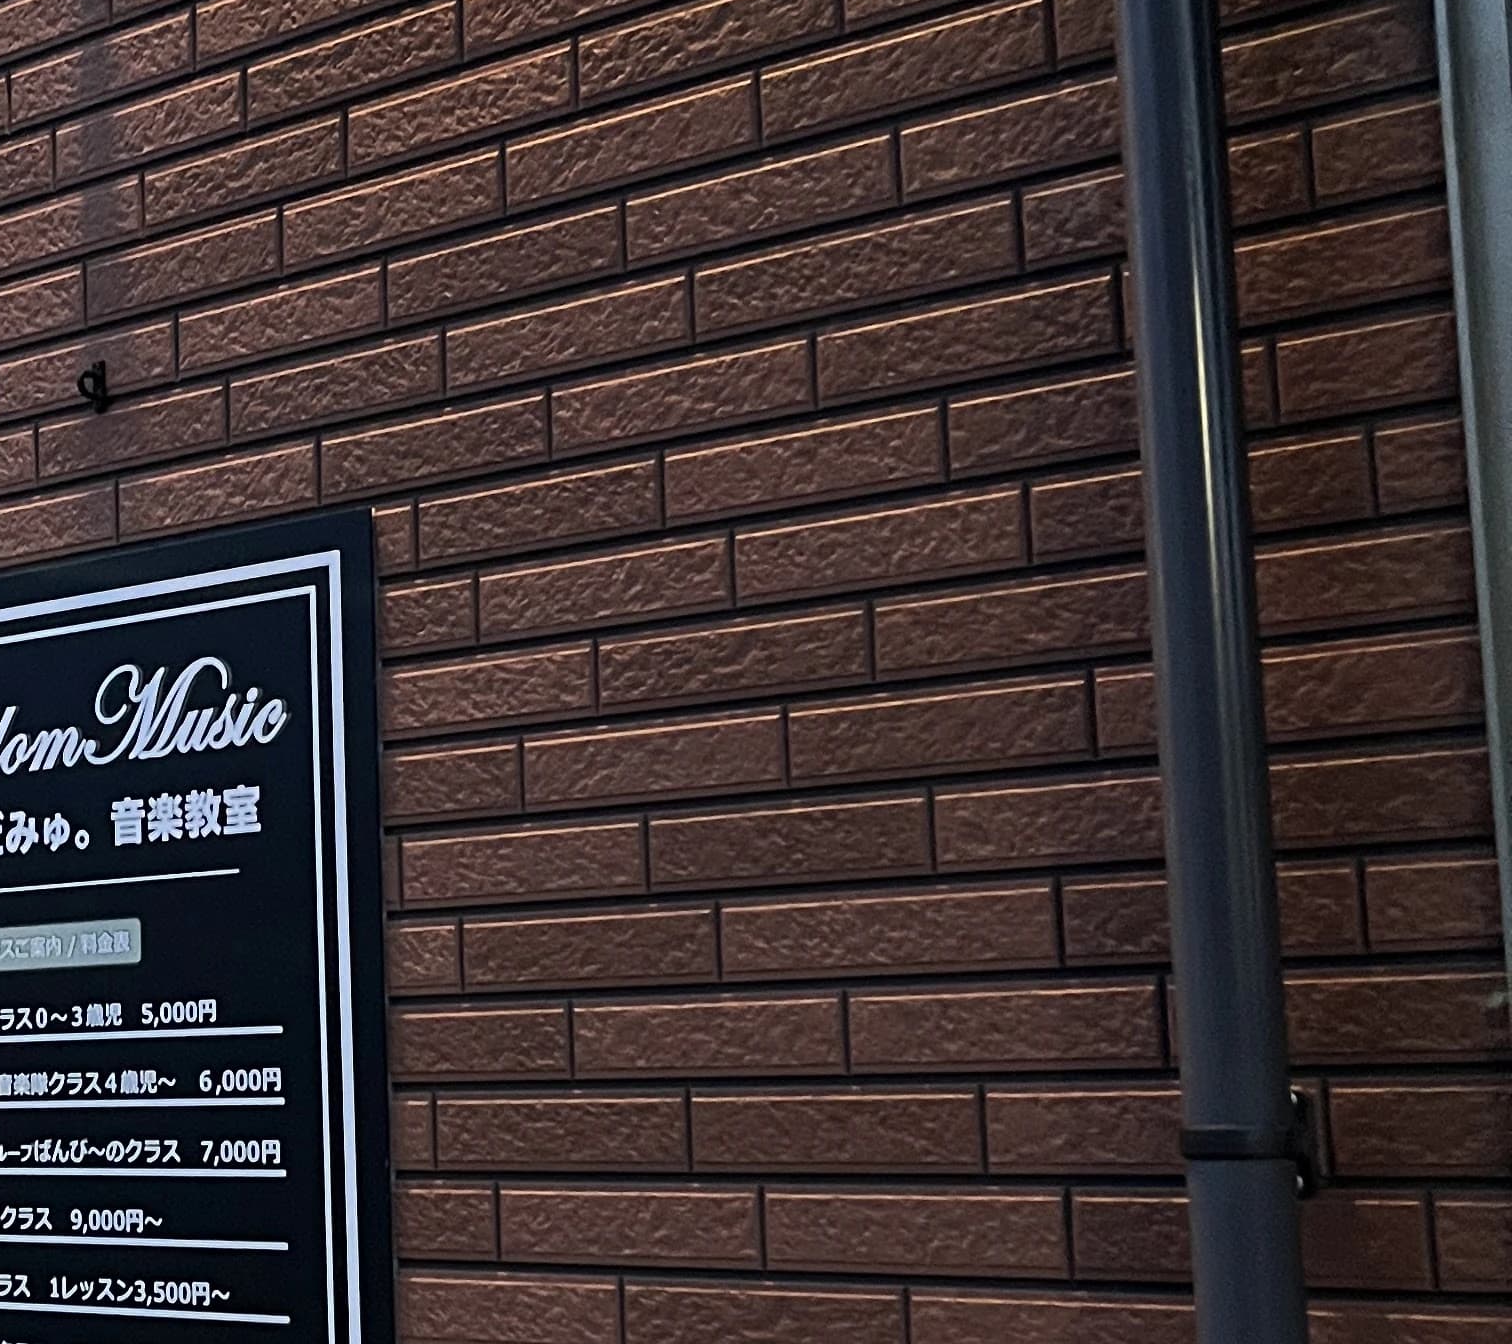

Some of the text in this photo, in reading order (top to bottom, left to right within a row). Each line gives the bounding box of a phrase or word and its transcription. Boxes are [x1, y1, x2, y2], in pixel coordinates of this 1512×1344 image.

[85, 657, 287, 764] Music
[111, 785, 261, 846] 音楽教室
[141, 999, 217, 1029] 5,000円
[200, 1068, 281, 1095] 6,000円
[201, 1140, 280, 1166] 7,000円
